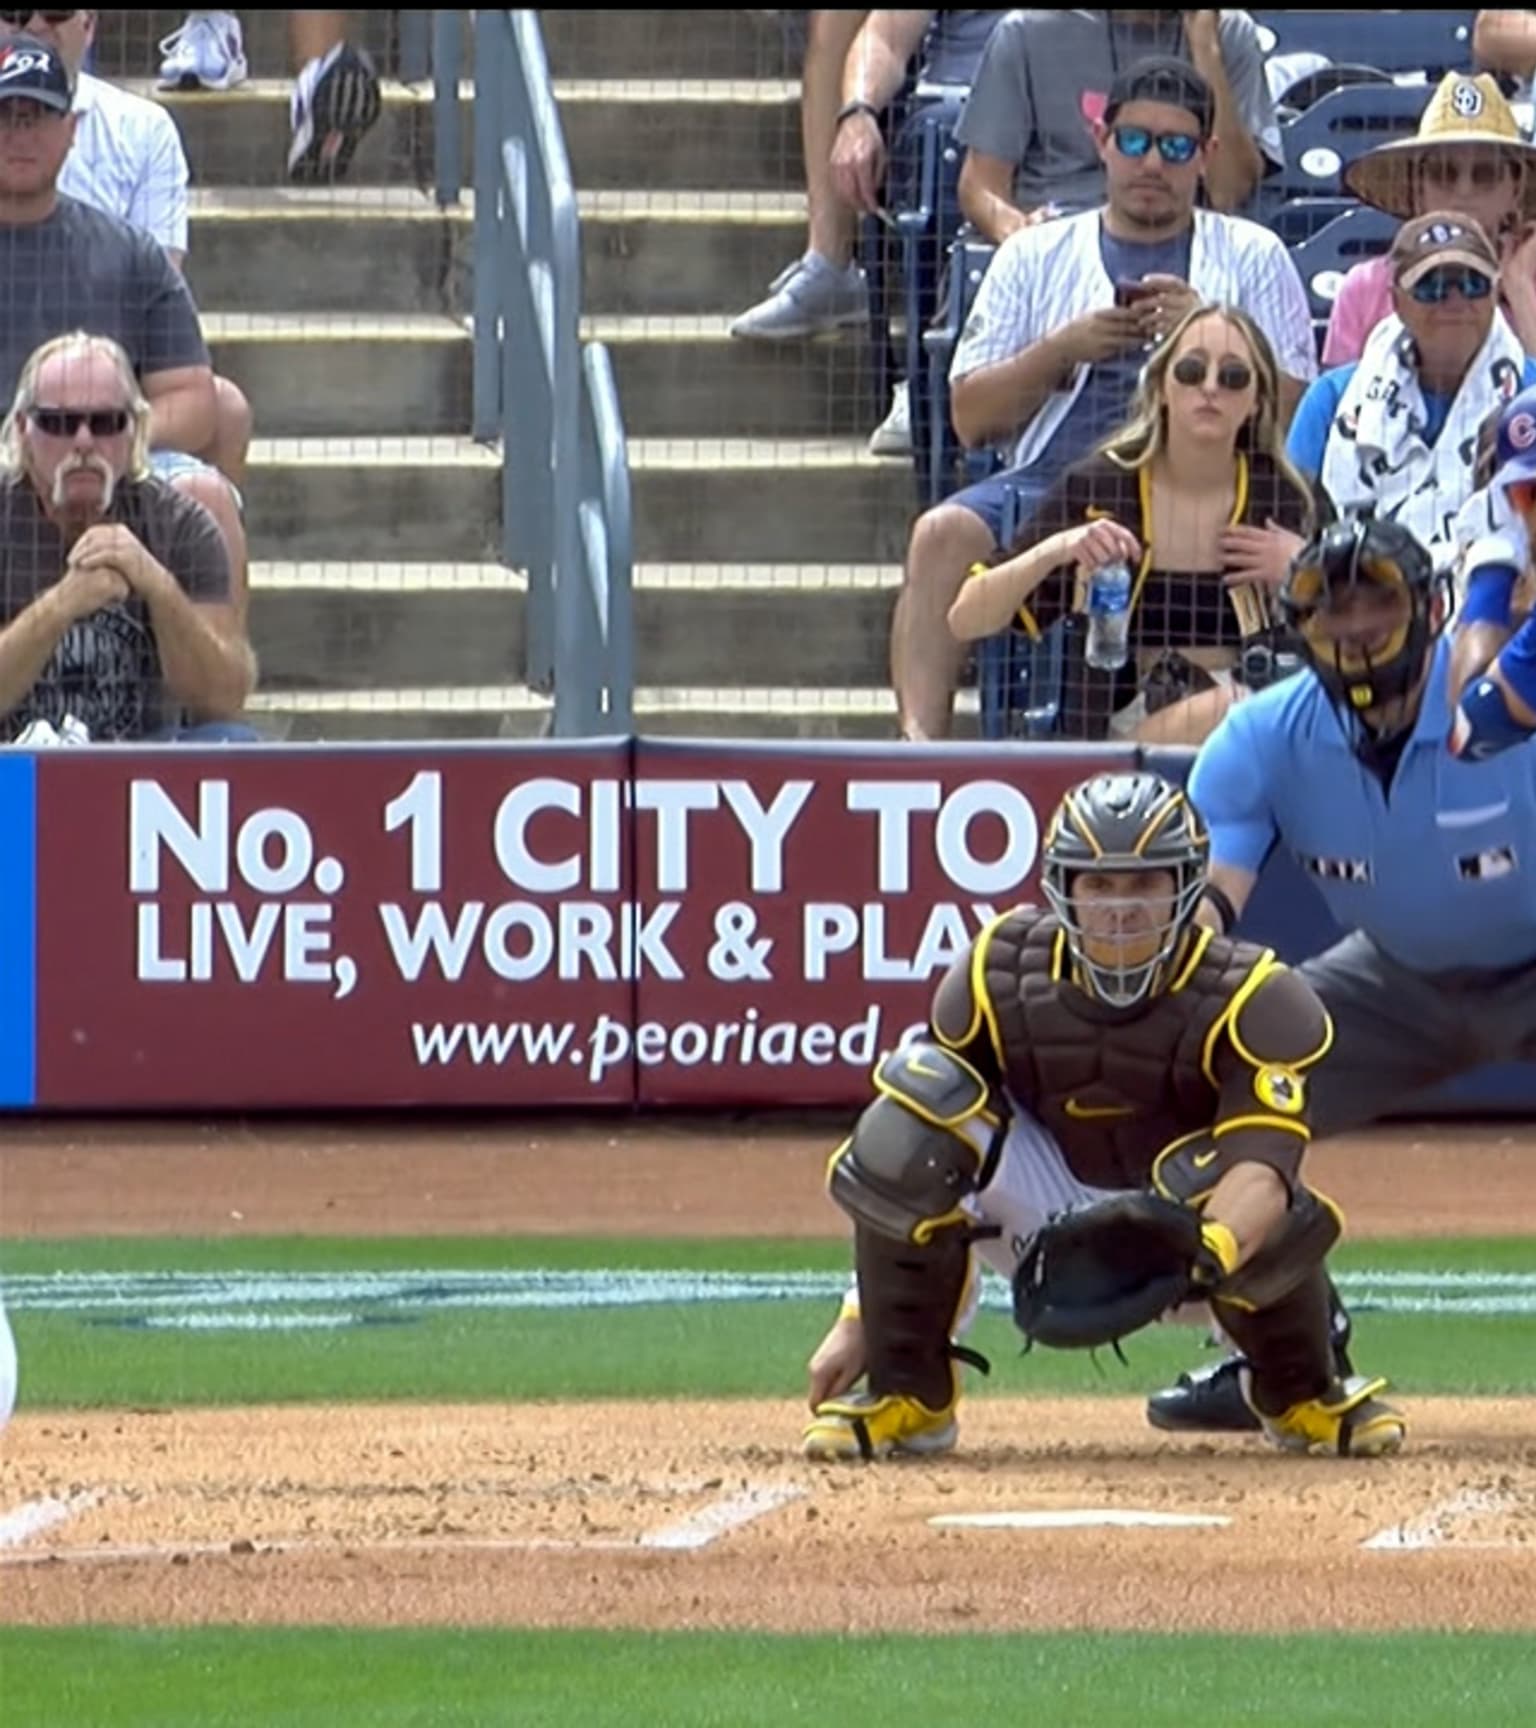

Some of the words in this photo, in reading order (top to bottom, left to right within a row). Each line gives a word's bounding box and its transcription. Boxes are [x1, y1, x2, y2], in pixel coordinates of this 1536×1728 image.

[129, 779, 344, 895] No.
[384, 770, 442, 892] 1
[493, 776, 816, 894] CITY
[847, 779, 1039, 895] TO
[137, 902, 358, 1000] LIVE,
[378, 901, 685, 981] WORK
[707, 901, 774, 981] &
